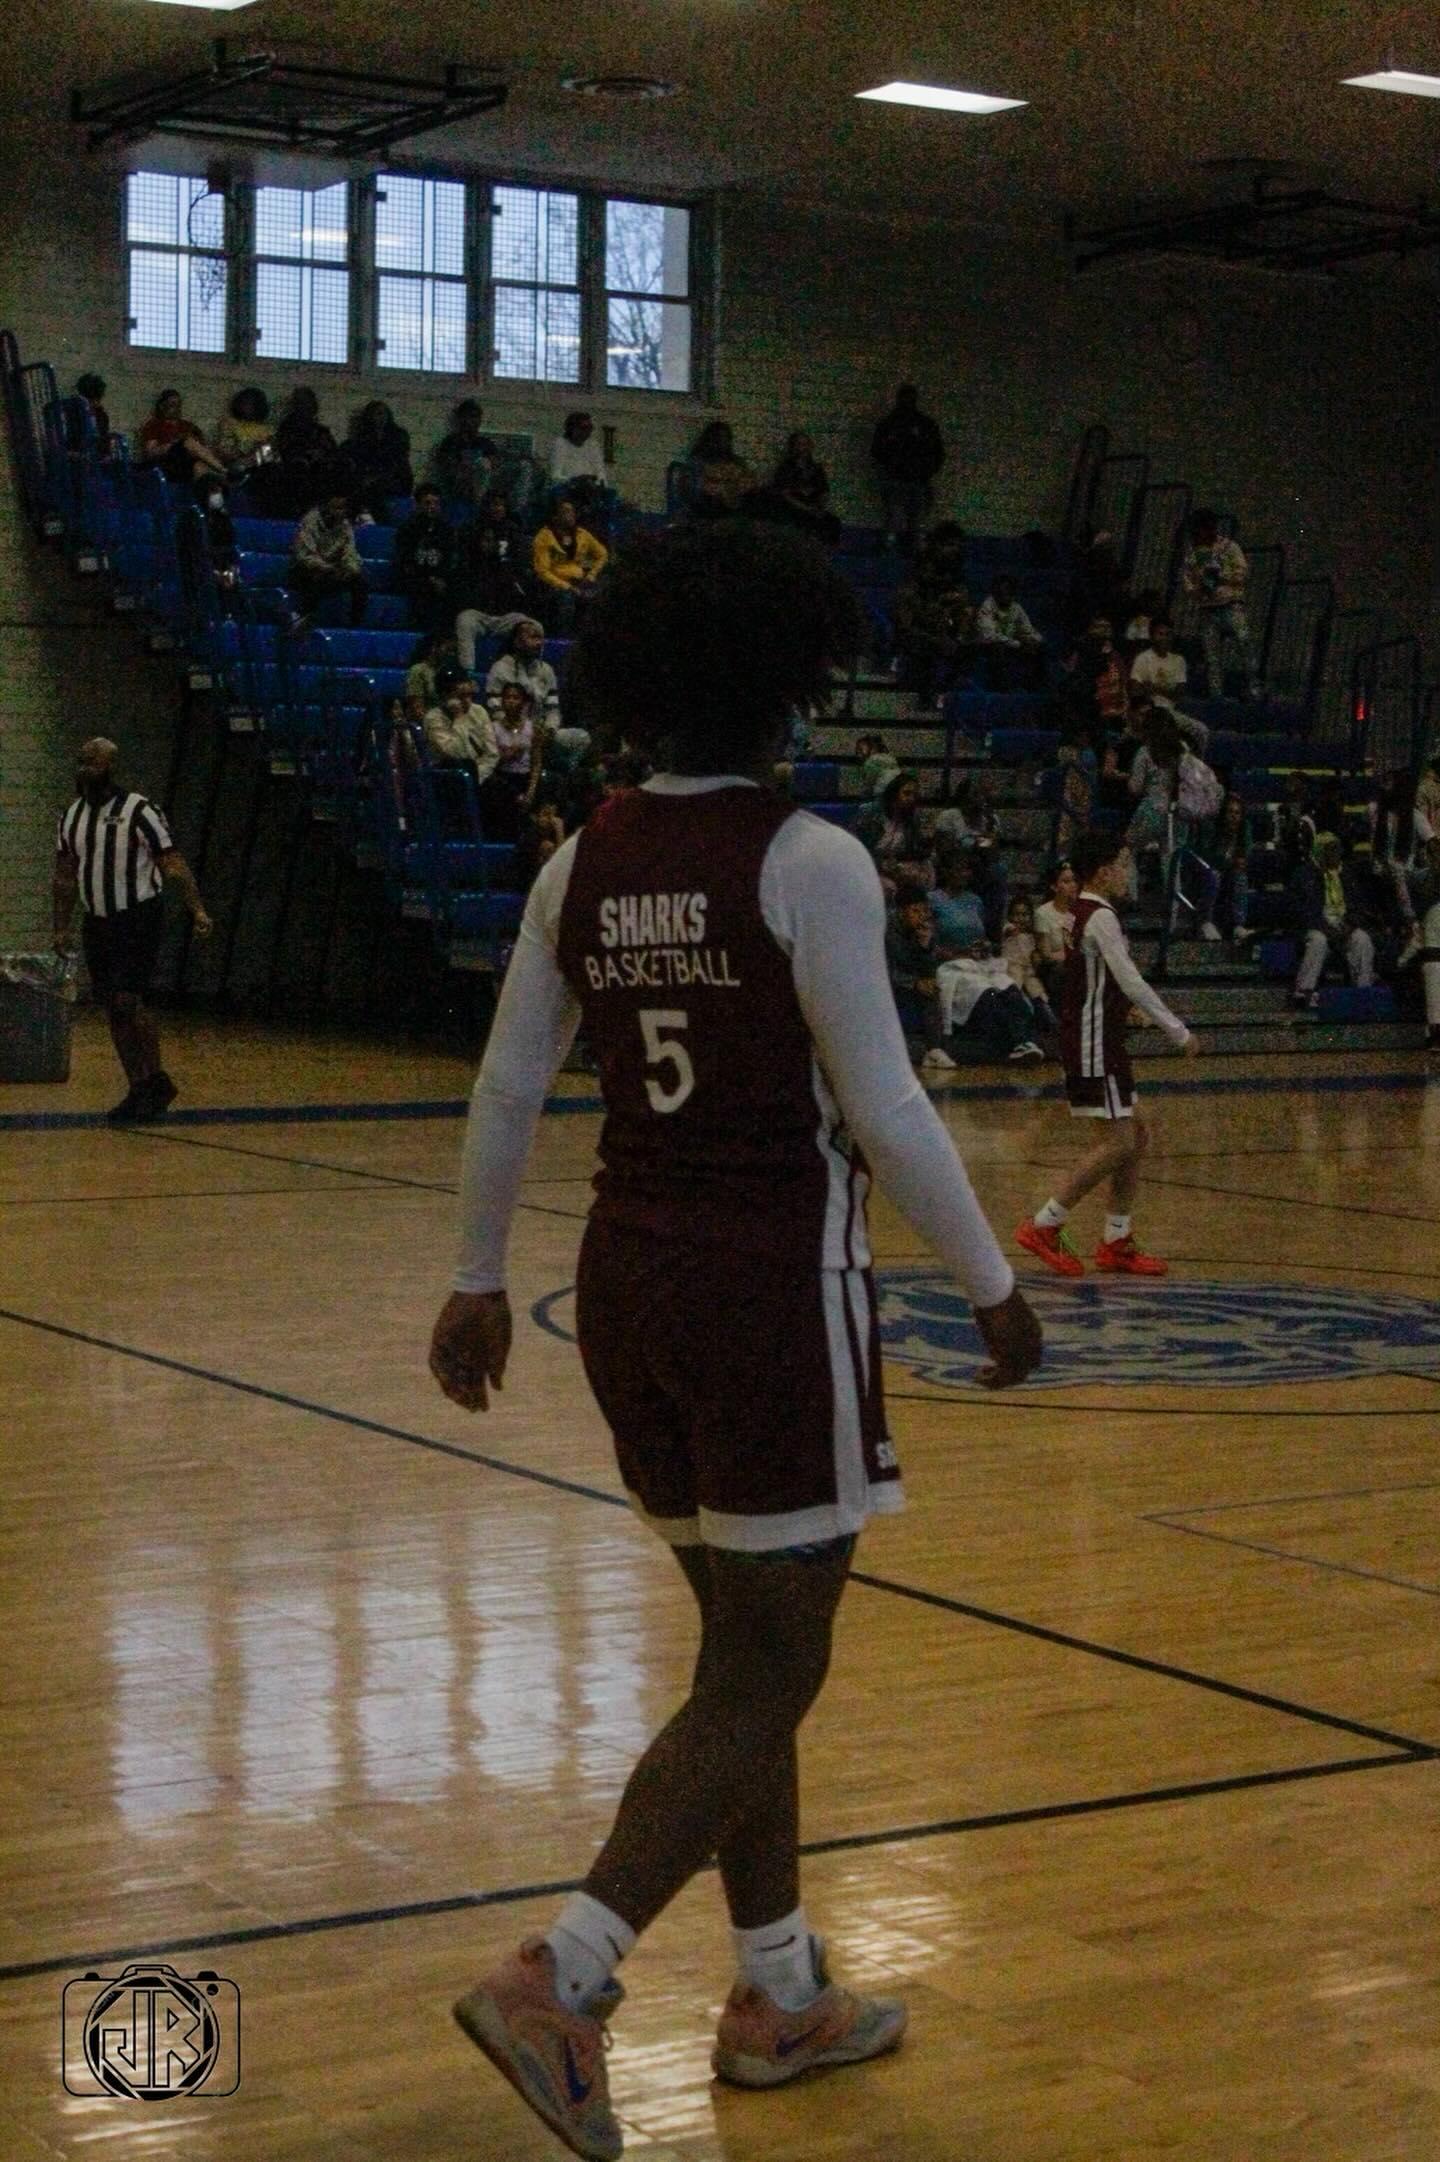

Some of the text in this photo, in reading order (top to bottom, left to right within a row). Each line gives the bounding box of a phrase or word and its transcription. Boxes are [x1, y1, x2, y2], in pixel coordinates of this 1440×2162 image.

[600, 892, 709, 948] SHARKS
[584, 949, 742, 990] BASKETBALL
[639, 1008, 695, 1114] 5
